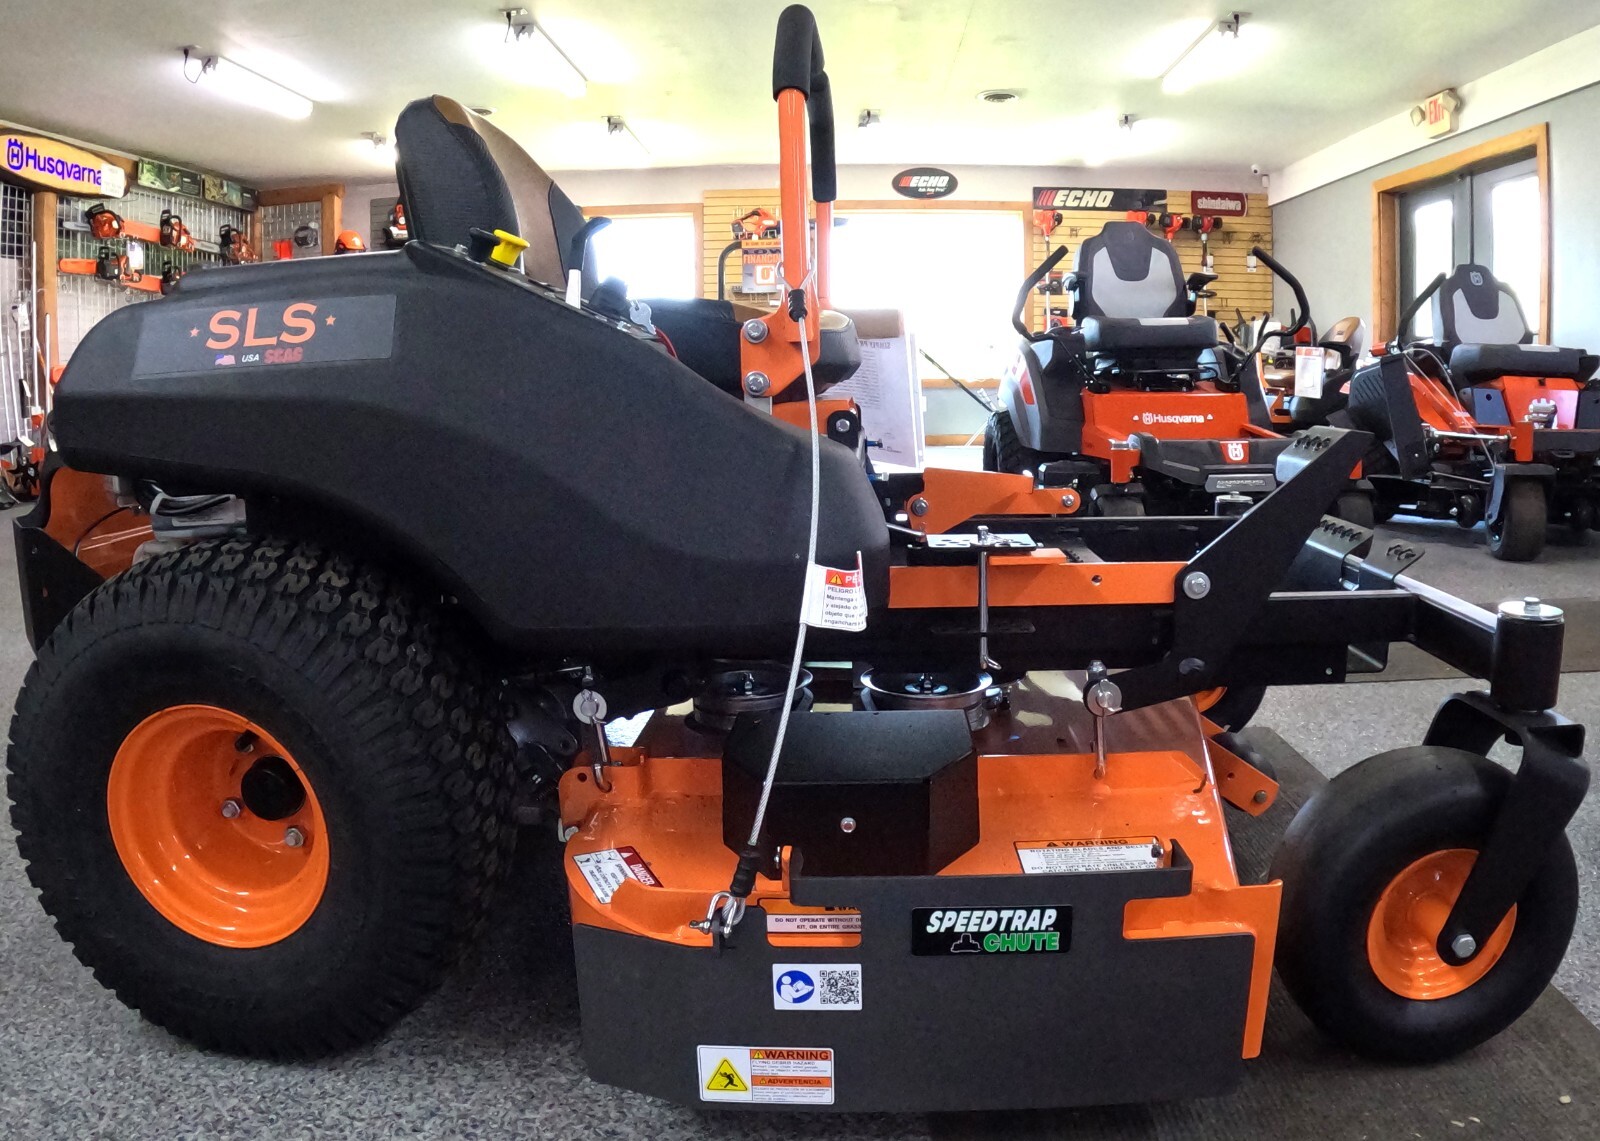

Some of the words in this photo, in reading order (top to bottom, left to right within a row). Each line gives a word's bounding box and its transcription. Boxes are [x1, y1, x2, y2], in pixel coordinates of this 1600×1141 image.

[25, 146, 102, 186] Husqvarna
[910, 176, 949, 187] ECHO
[1053, 190, 1114, 208] ECHO
[1197, 198, 1241, 210] shindaiwa
[743, 254, 781, 265] FINANCIN
[205, 302, 317, 350] SLS
[242, 354, 259, 362] USA
[1154, 414, 1204, 424] Husqvarna
[828, 586, 854, 594] PELIGRO
[826, 594, 854, 603] Mantenga
[1062, 838, 1129, 847] WARNING
[631, 864, 655, 886] DANGER
[926, 909, 1058, 934] SPEEDTRAP
[983, 932, 1060, 952] CHUTE
[765, 1050, 829, 1060] WARNING
